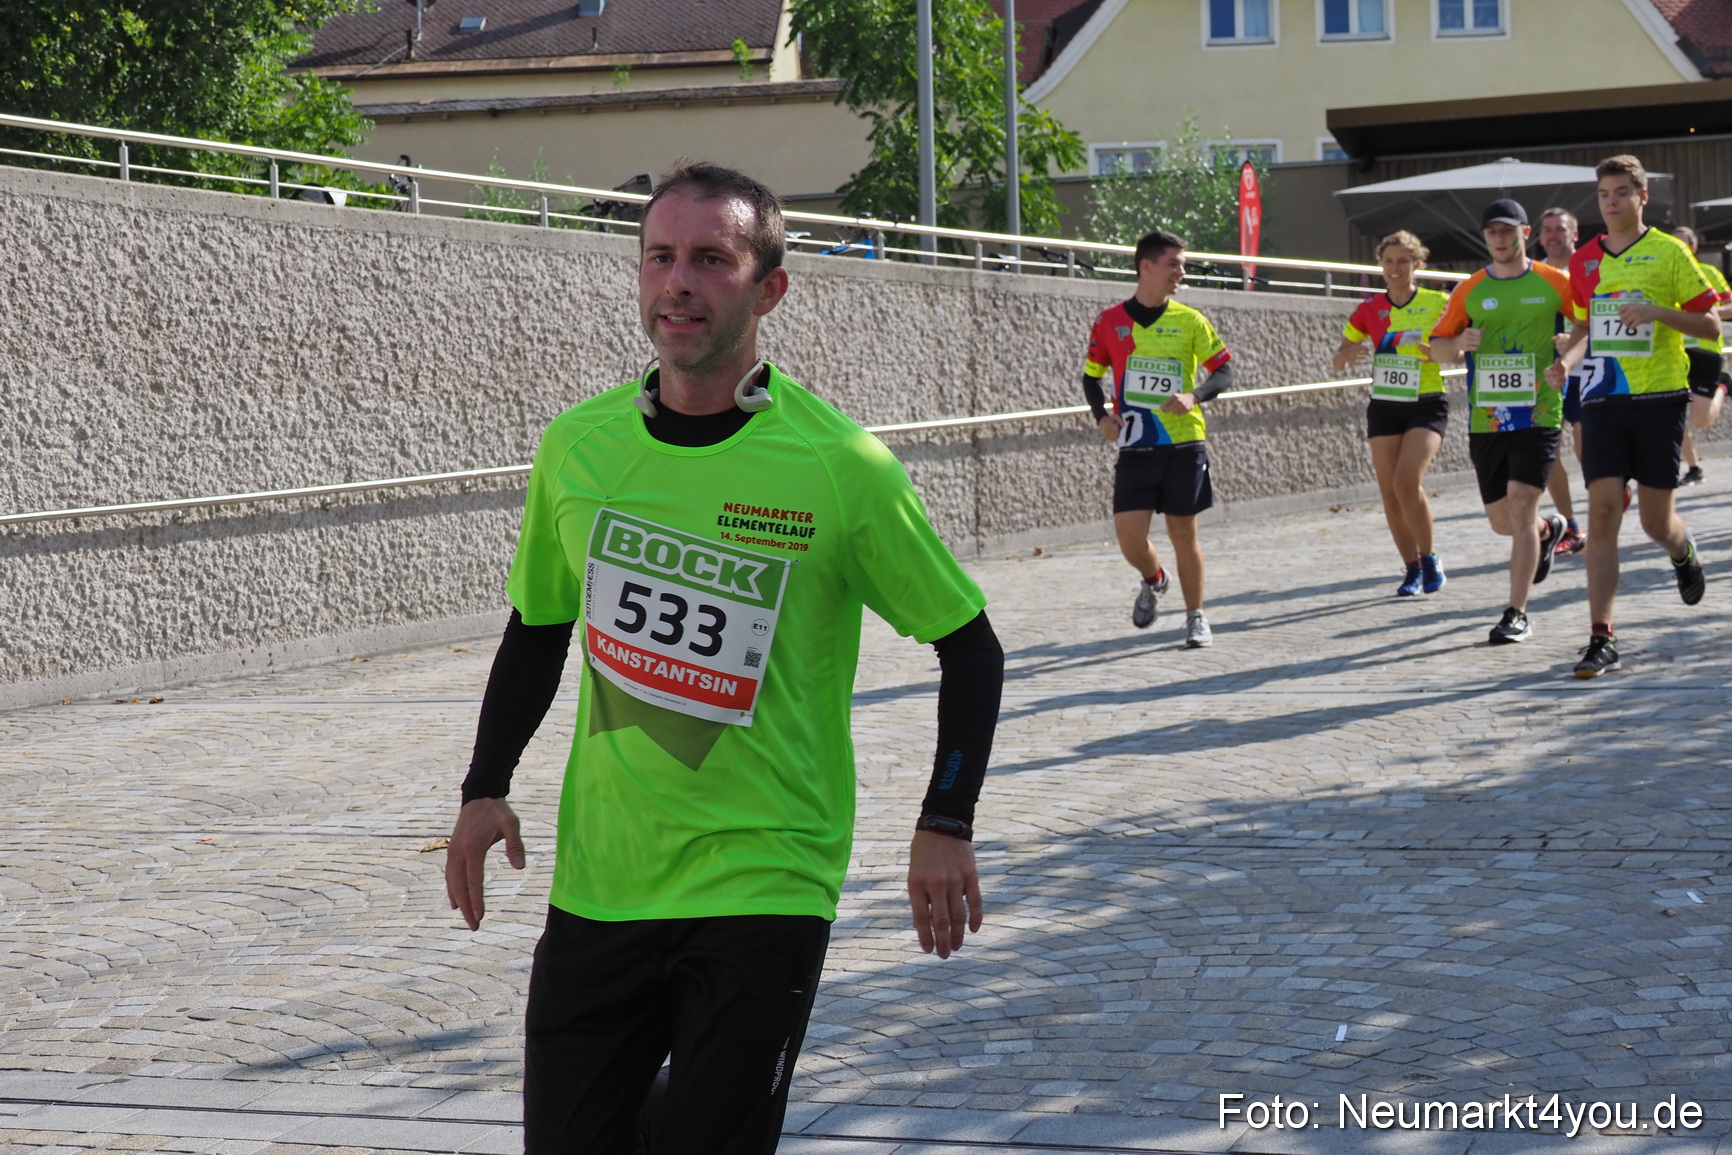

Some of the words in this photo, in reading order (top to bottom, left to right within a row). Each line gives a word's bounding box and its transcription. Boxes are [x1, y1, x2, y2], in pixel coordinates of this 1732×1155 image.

[1132, 359, 1178, 374] BOCK
[1480, 357, 1528, 369] BOCK
[1138, 375, 1172, 393] 179
[1382, 370, 1408, 386] 180
[1488, 372, 1522, 389] 188
[723, 502, 814, 524] NEUMARKTER
[717, 515, 816, 539] ELEMENTELAUF
[720, 531, 733, 541] 14.
[734, 533, 787, 549] September
[787, 541, 809, 552] 2019
[603, 521, 766, 599] BOCK
[614, 581, 728, 657] 533
[753, 623, 768, 631] E11
[596, 634, 738, 696] KANSTANTSIN
